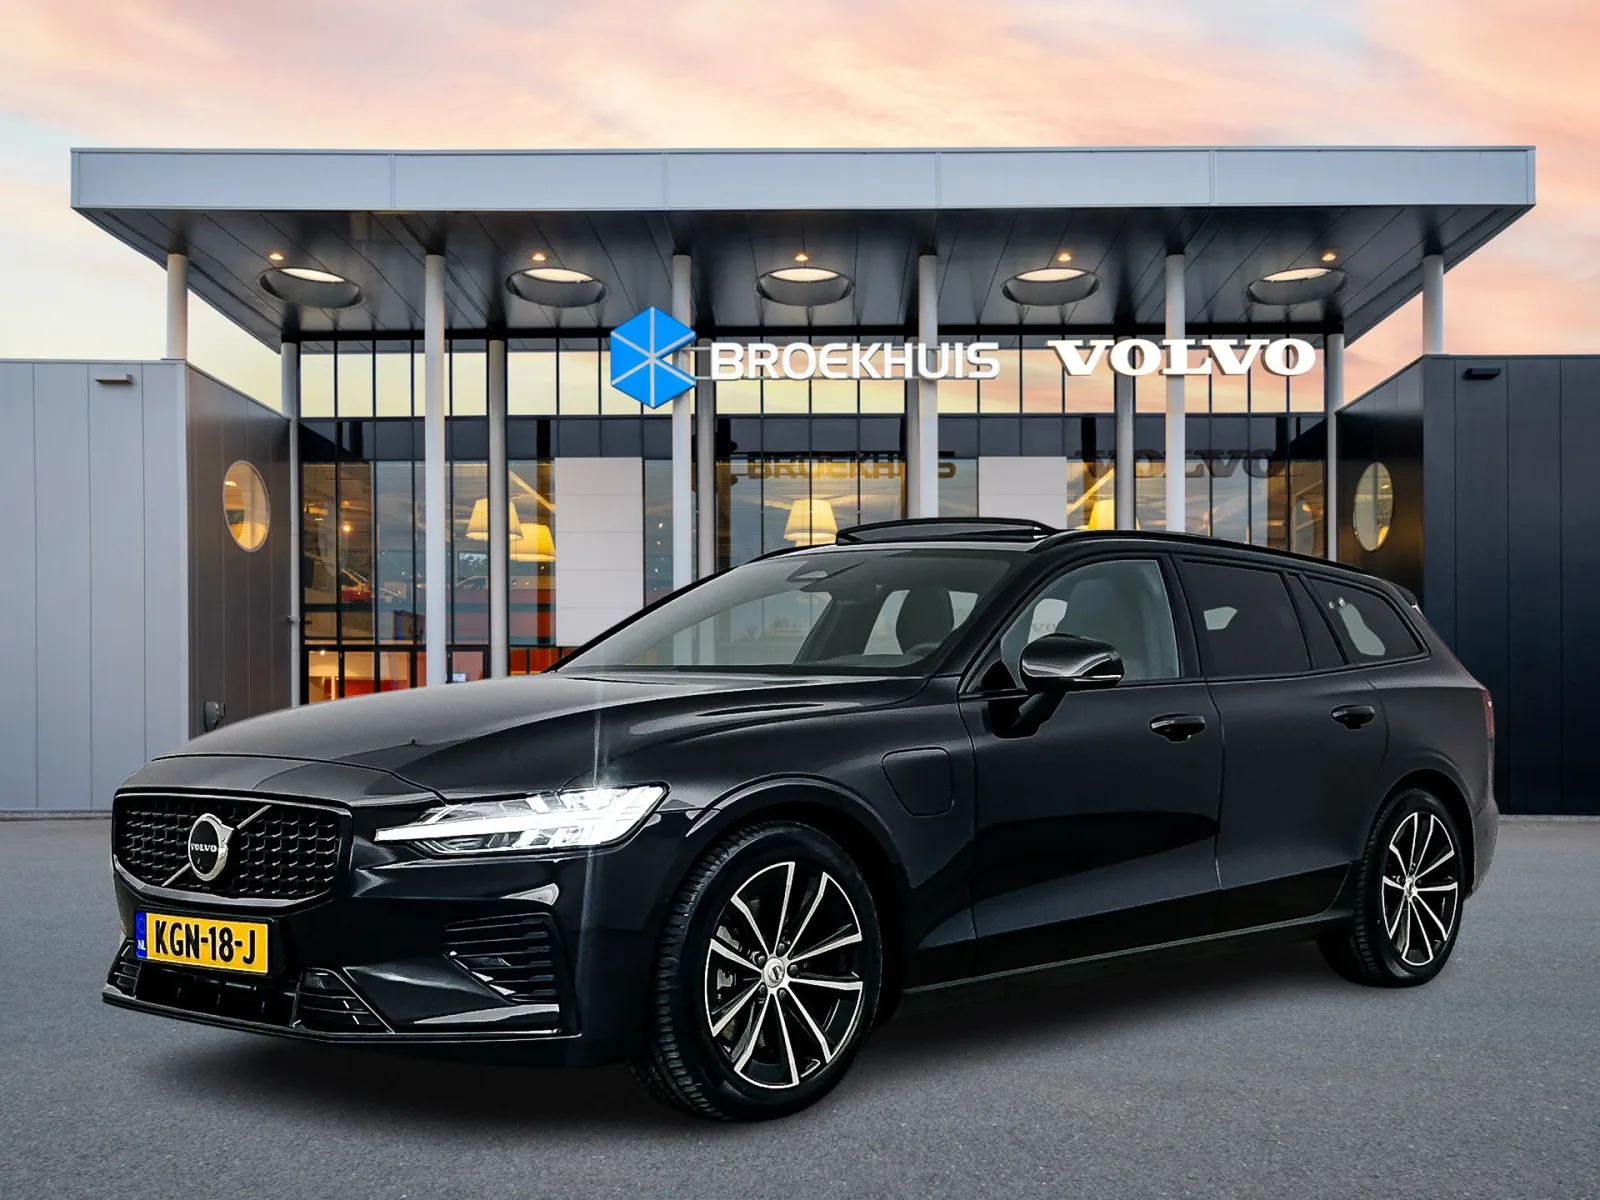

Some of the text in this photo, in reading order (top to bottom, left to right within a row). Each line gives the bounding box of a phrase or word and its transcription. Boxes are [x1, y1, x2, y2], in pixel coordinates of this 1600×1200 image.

[711, 342, 1000, 379] BROEKHUIS
[1046, 338, 1316, 376] VOLVO
[155, 920, 256, 964] KGN-18-J
